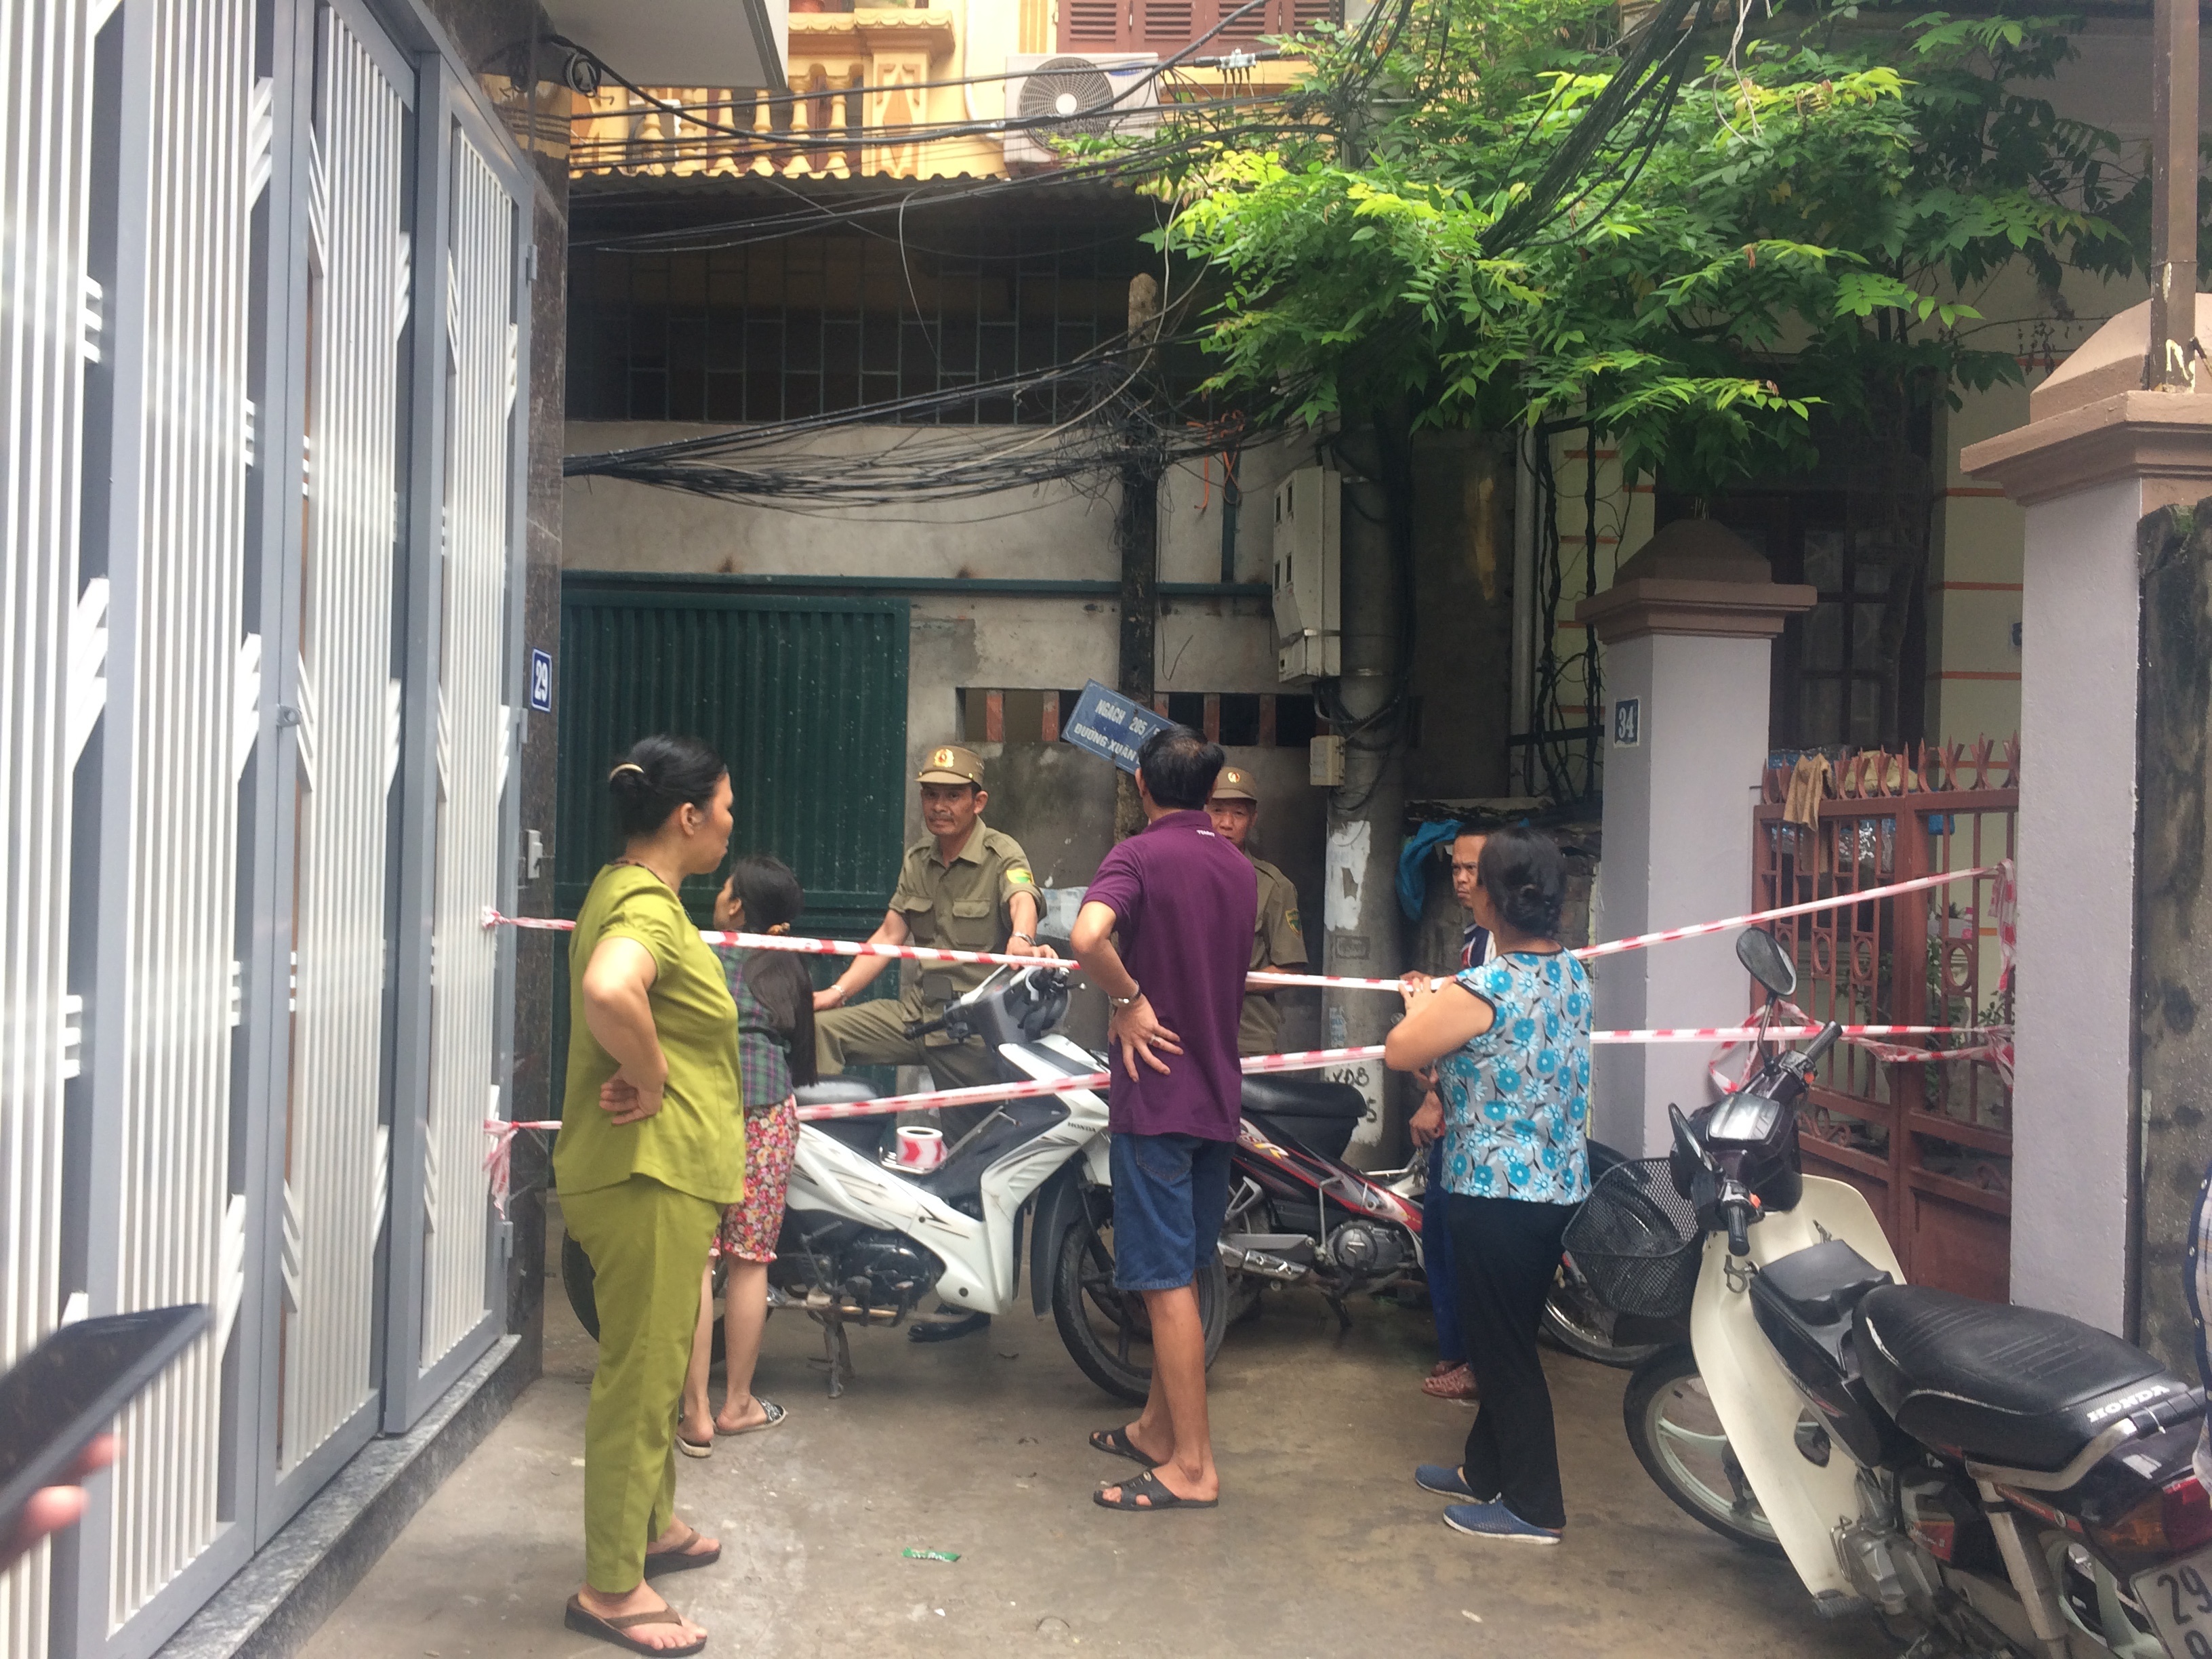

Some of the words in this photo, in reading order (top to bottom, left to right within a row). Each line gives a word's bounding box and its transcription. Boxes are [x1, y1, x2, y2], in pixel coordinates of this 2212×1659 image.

[535, 659, 548, 702] 29
[1618, 706, 1634, 739] 34
[1067, 1122, 1097, 1132] HONDA
[2087, 1385, 2171, 1424] HONDA
[2157, 1565, 2212, 1625] 29
